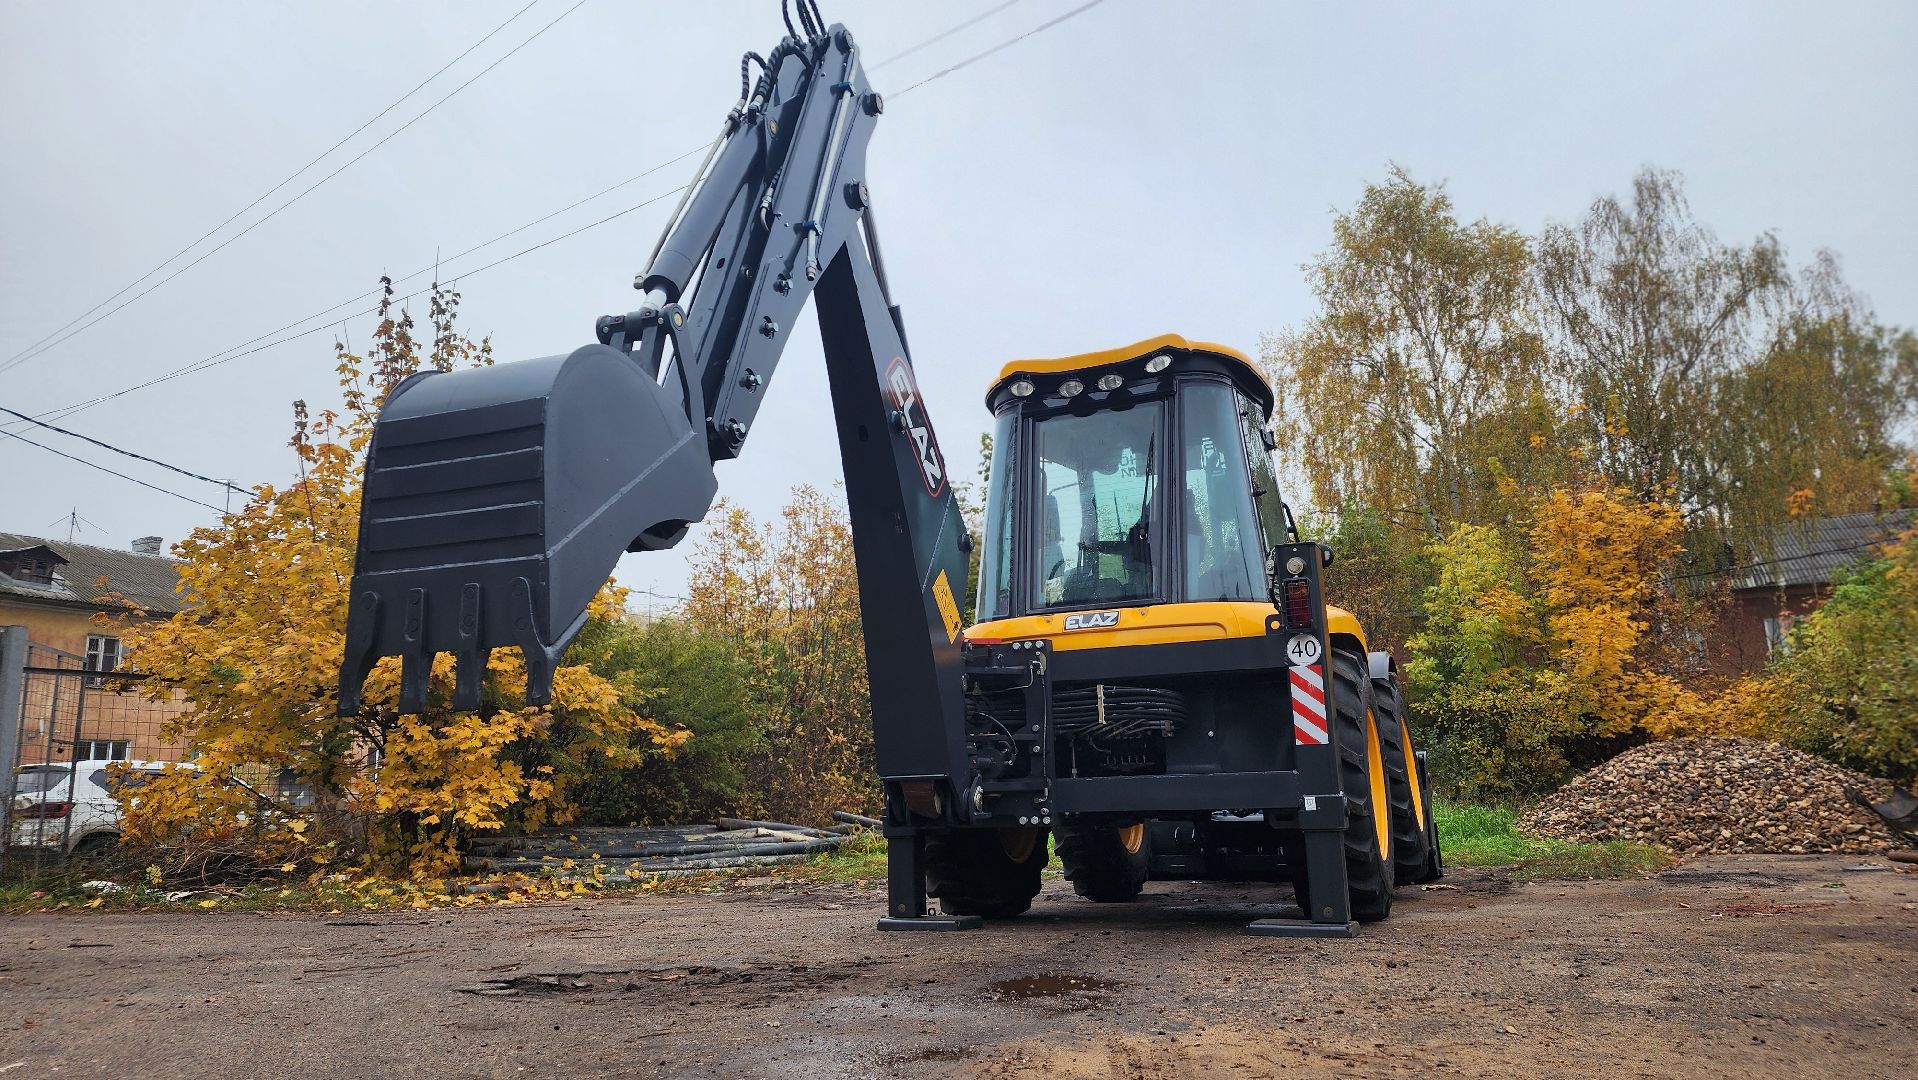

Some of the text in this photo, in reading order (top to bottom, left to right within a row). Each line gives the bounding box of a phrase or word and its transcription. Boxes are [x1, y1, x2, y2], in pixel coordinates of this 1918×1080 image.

[890, 365, 942, 488] ELAZ
[1065, 611, 1119, 630] ELAZ
[1292, 640, 1317, 658] 40
